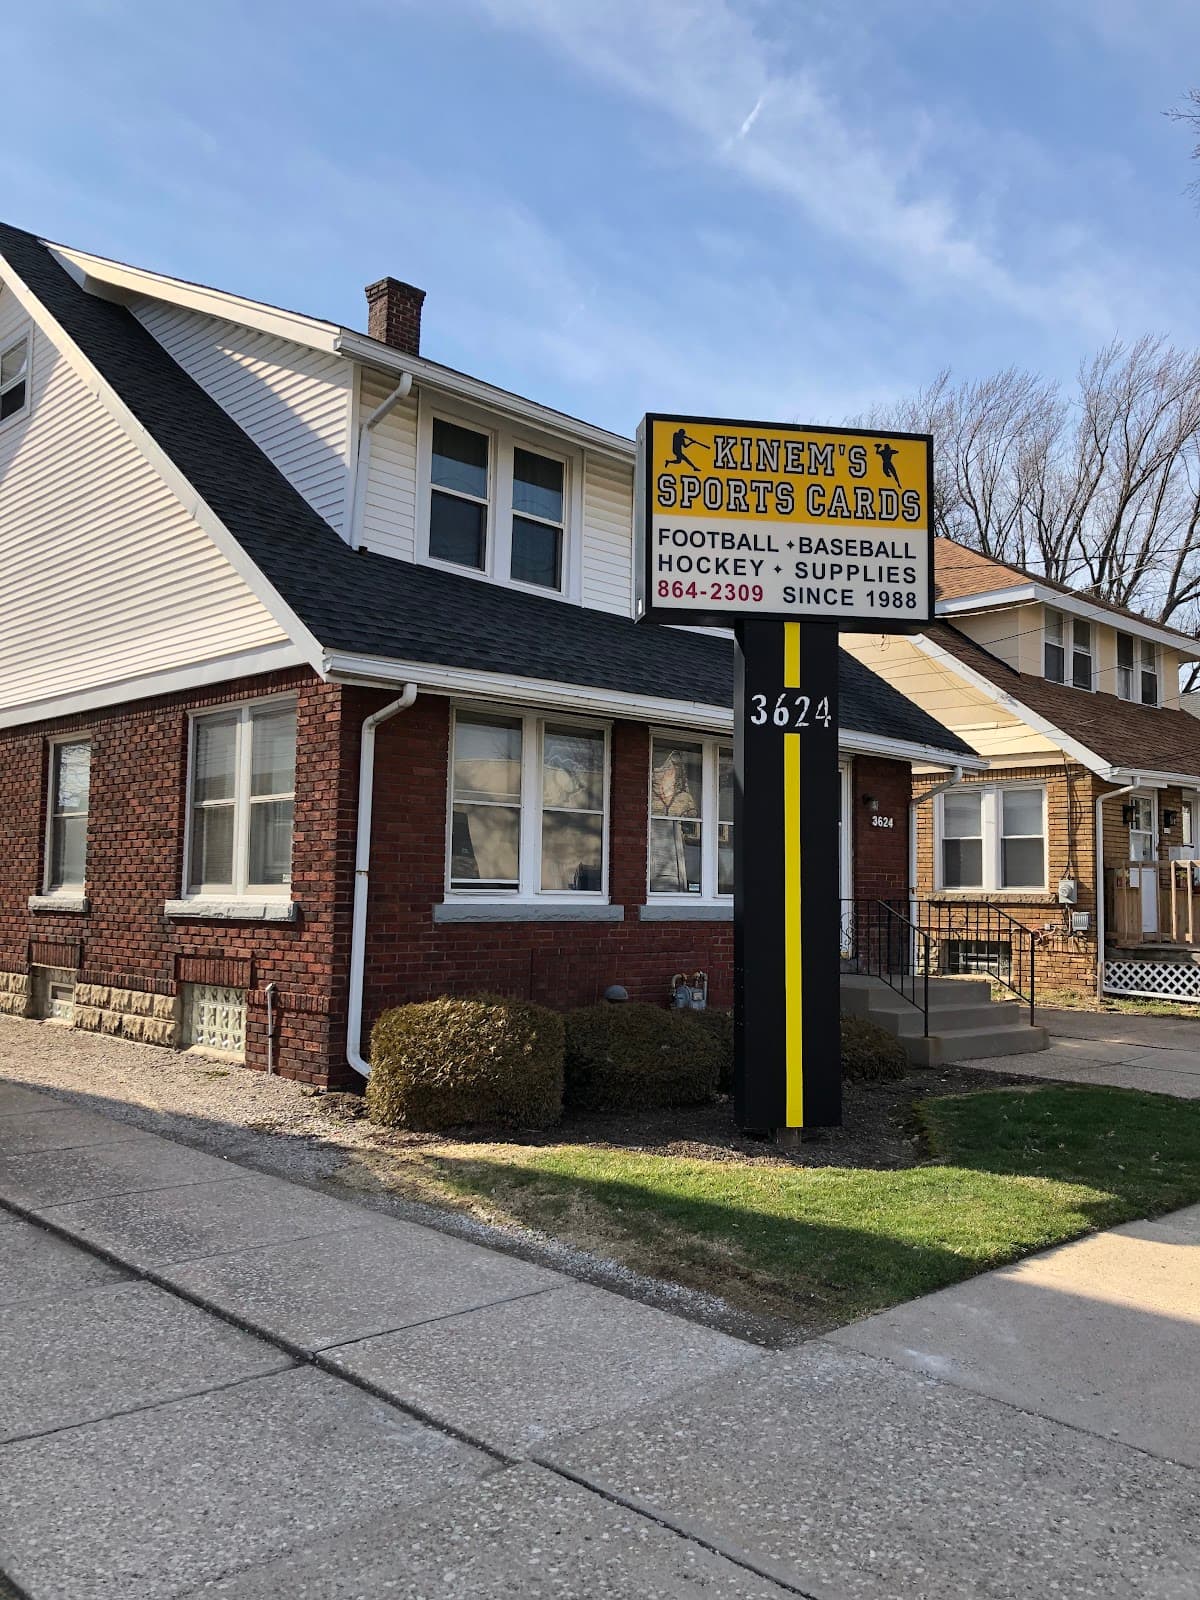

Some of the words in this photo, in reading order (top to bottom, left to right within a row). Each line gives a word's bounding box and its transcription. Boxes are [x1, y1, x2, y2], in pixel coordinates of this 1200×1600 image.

[713, 435, 867, 478] KINEM'S
[657, 473, 795, 515] SPORTS
[806, 484, 921, 522] CARDS
[658, 528, 780, 553] FOOTBALL
[799, 536, 917, 559] BASEBALL
[658, 554, 765, 577] HOCKEY
[795, 562, 917, 583] SUPPLIES
[657, 580, 764, 602] 864-2309
[782, 586, 854, 606] SINCE
[866, 590, 917, 609] 1988
[750, 693, 832, 728] 3624
[871, 815, 894, 828] 3624
